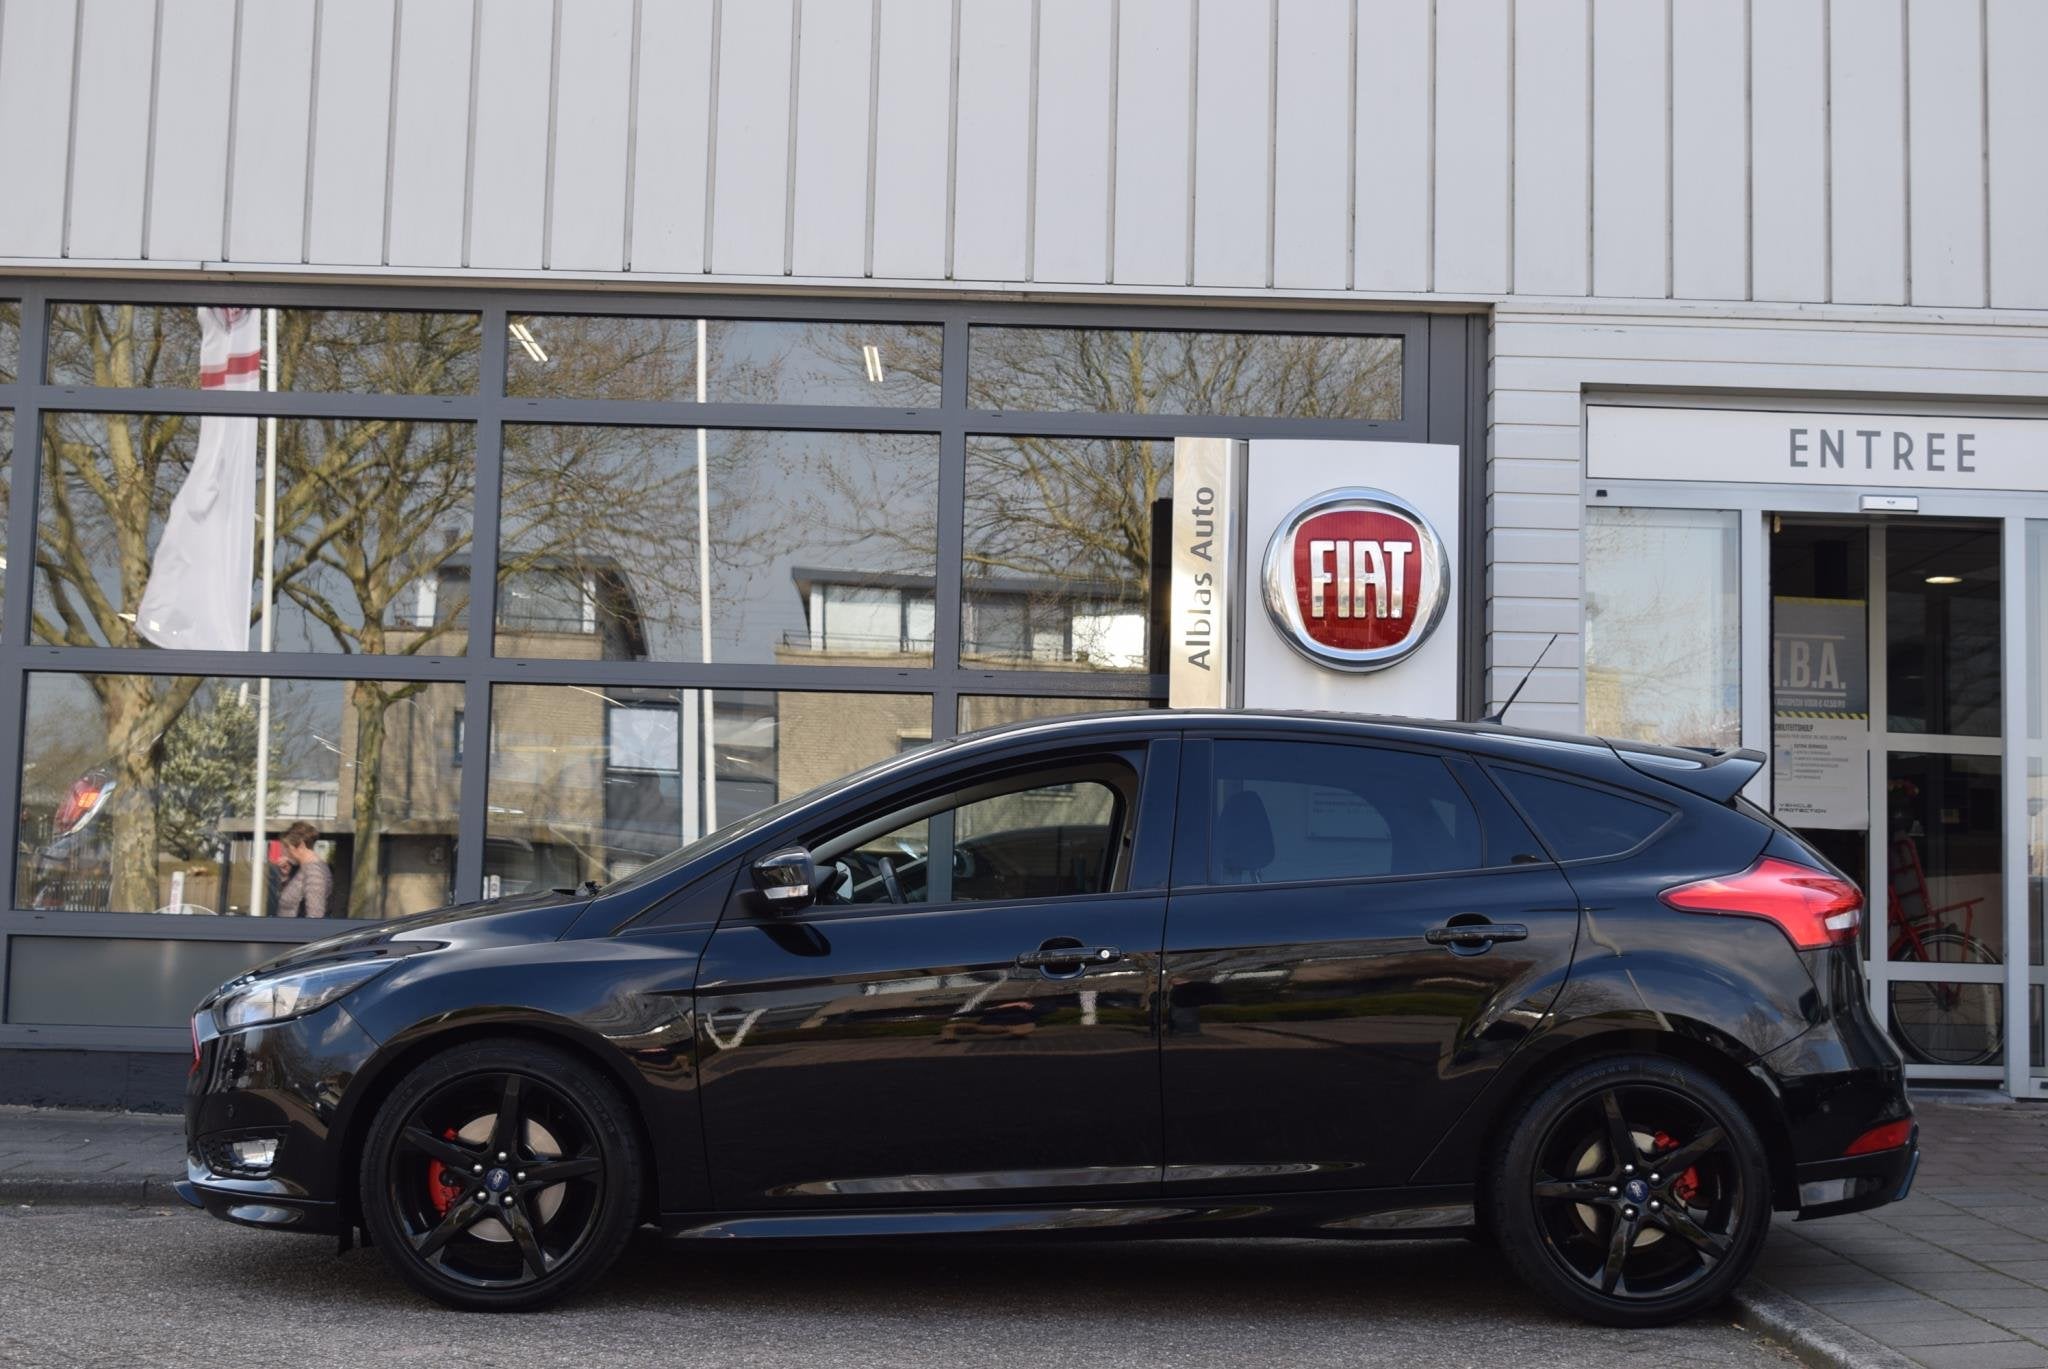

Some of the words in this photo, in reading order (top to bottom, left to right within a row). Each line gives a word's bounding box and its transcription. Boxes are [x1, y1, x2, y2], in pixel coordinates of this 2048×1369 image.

[1789, 428, 1977, 473] ENTREE
[1189, 486, 1215, 563] Auto
[1309, 539, 1414, 620] FIAT
[1187, 574, 1213, 672] Alblas
